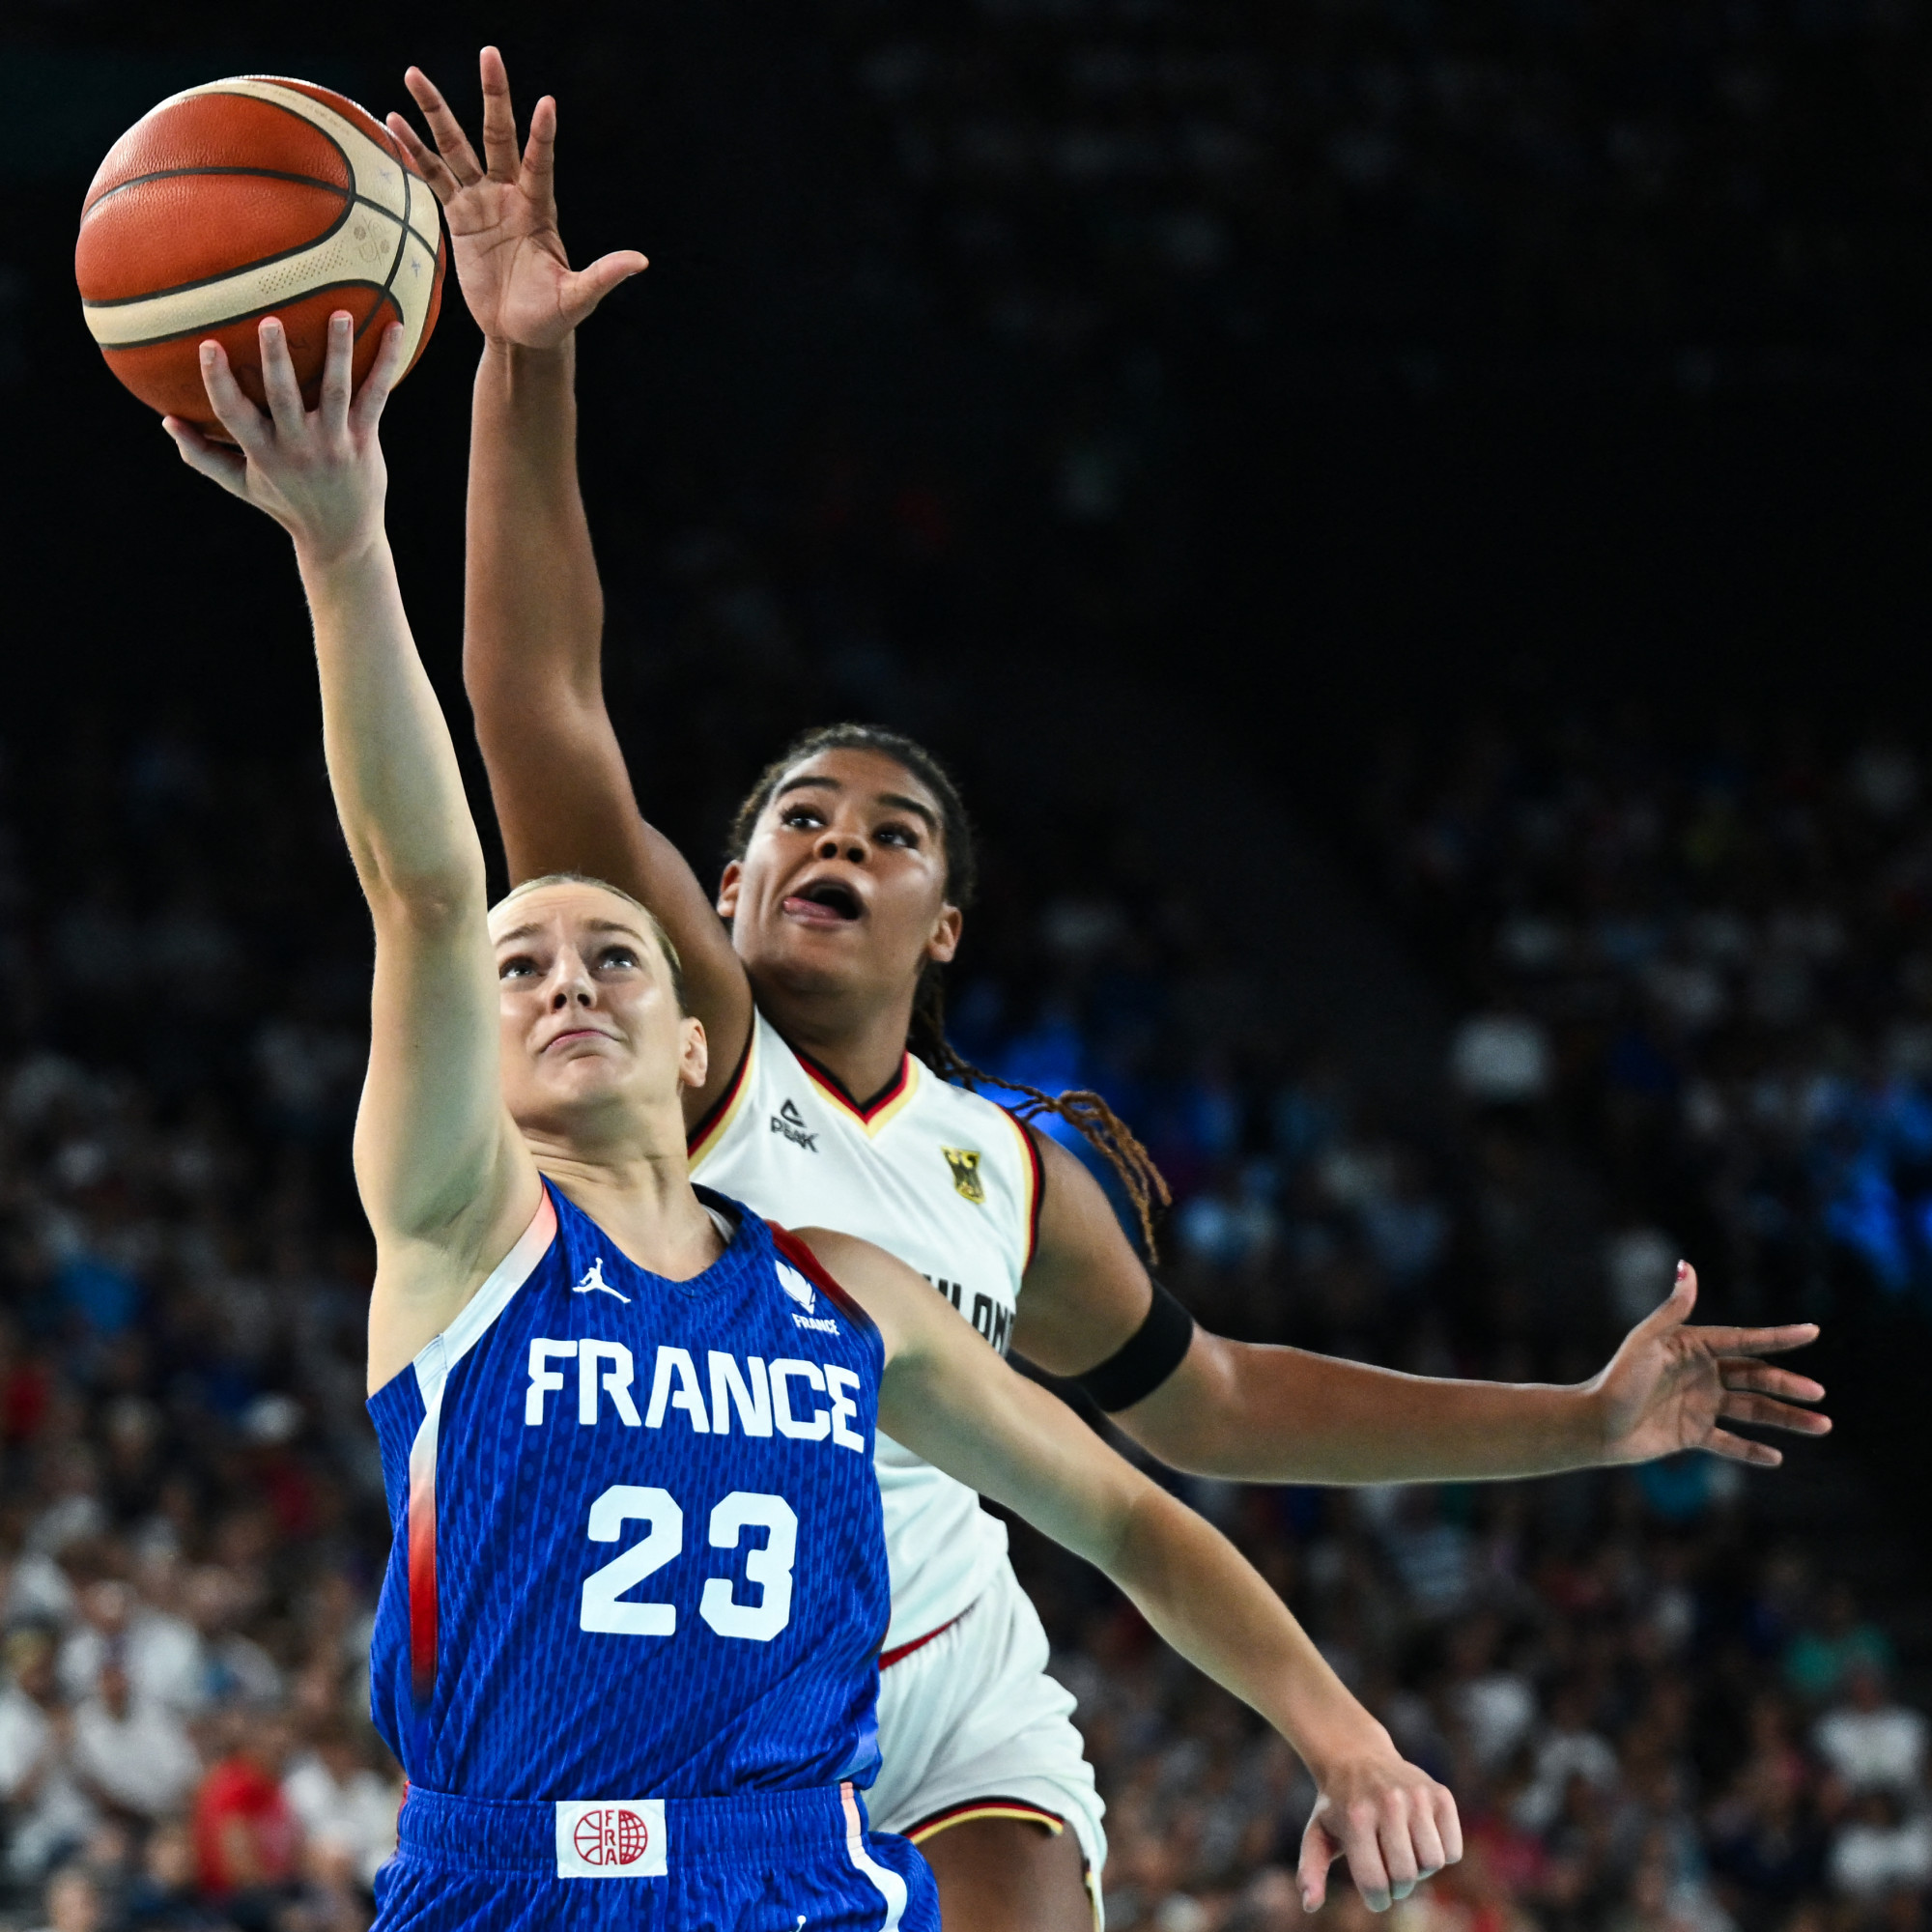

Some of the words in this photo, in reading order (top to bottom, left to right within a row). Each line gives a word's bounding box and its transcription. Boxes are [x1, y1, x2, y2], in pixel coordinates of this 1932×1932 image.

[770, 1116, 819, 1153] PEAK
[791, 1313, 840, 1336] FRANCE
[525, 1338, 865, 1453] FRANCE
[580, 1485, 798, 1641] 23
[605, 1809, 618, 1865] FRA
